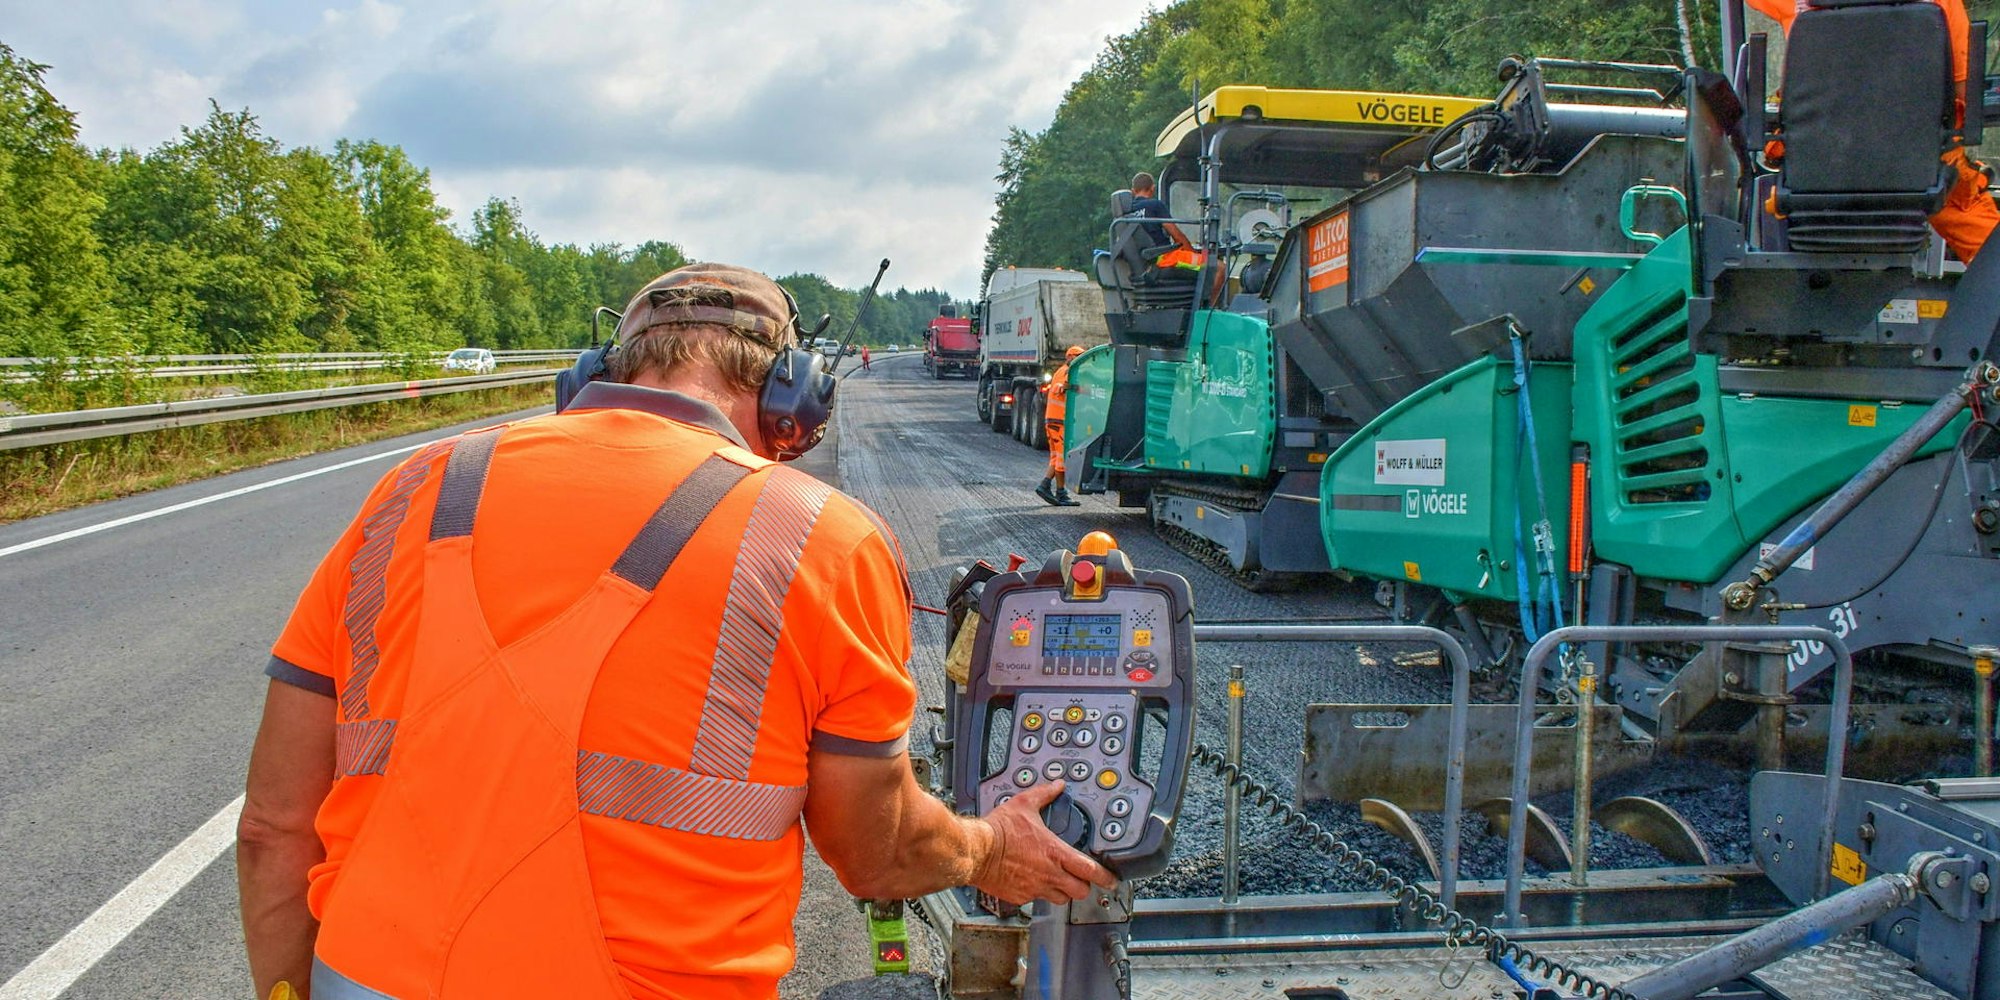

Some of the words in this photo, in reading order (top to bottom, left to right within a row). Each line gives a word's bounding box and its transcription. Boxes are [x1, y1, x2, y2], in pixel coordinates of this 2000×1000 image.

[1357, 98, 1444, 124] VÖGELE
[1386, 458, 1407, 469] WOLFF
[1408, 458, 1413, 469] &
[1415, 454, 1443, 469] MÜLLER
[1422, 488, 1467, 514] VÖGELE
[1053, 626, 1069, 635] -11
[1097, 626, 1112, 635] +0
[1056, 731, 1064, 741] R
